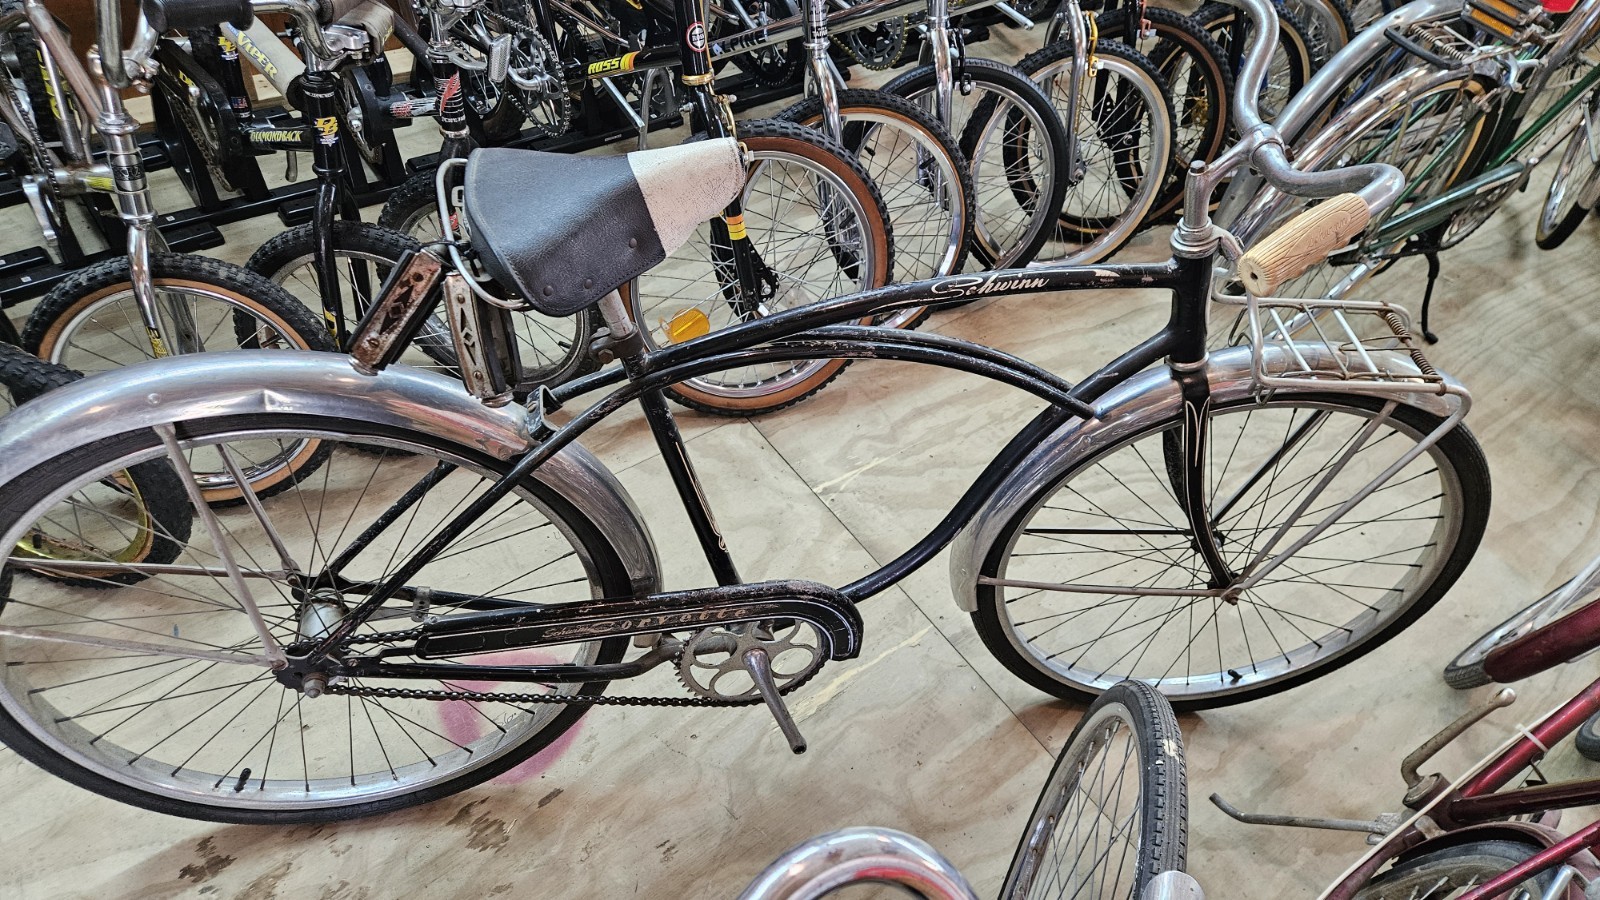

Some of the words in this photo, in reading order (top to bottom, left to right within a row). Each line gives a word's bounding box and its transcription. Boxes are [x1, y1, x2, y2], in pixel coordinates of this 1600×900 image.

[238, 30, 279, 79] VIPER
[711, 31, 768, 57] ALPINE
[587, 57, 622, 74] ROSS
[249, 130, 304, 142] DIAMONDBACK
[930, 272, 1050, 299] Schwinn
[590, 606, 748, 634] Corvette
